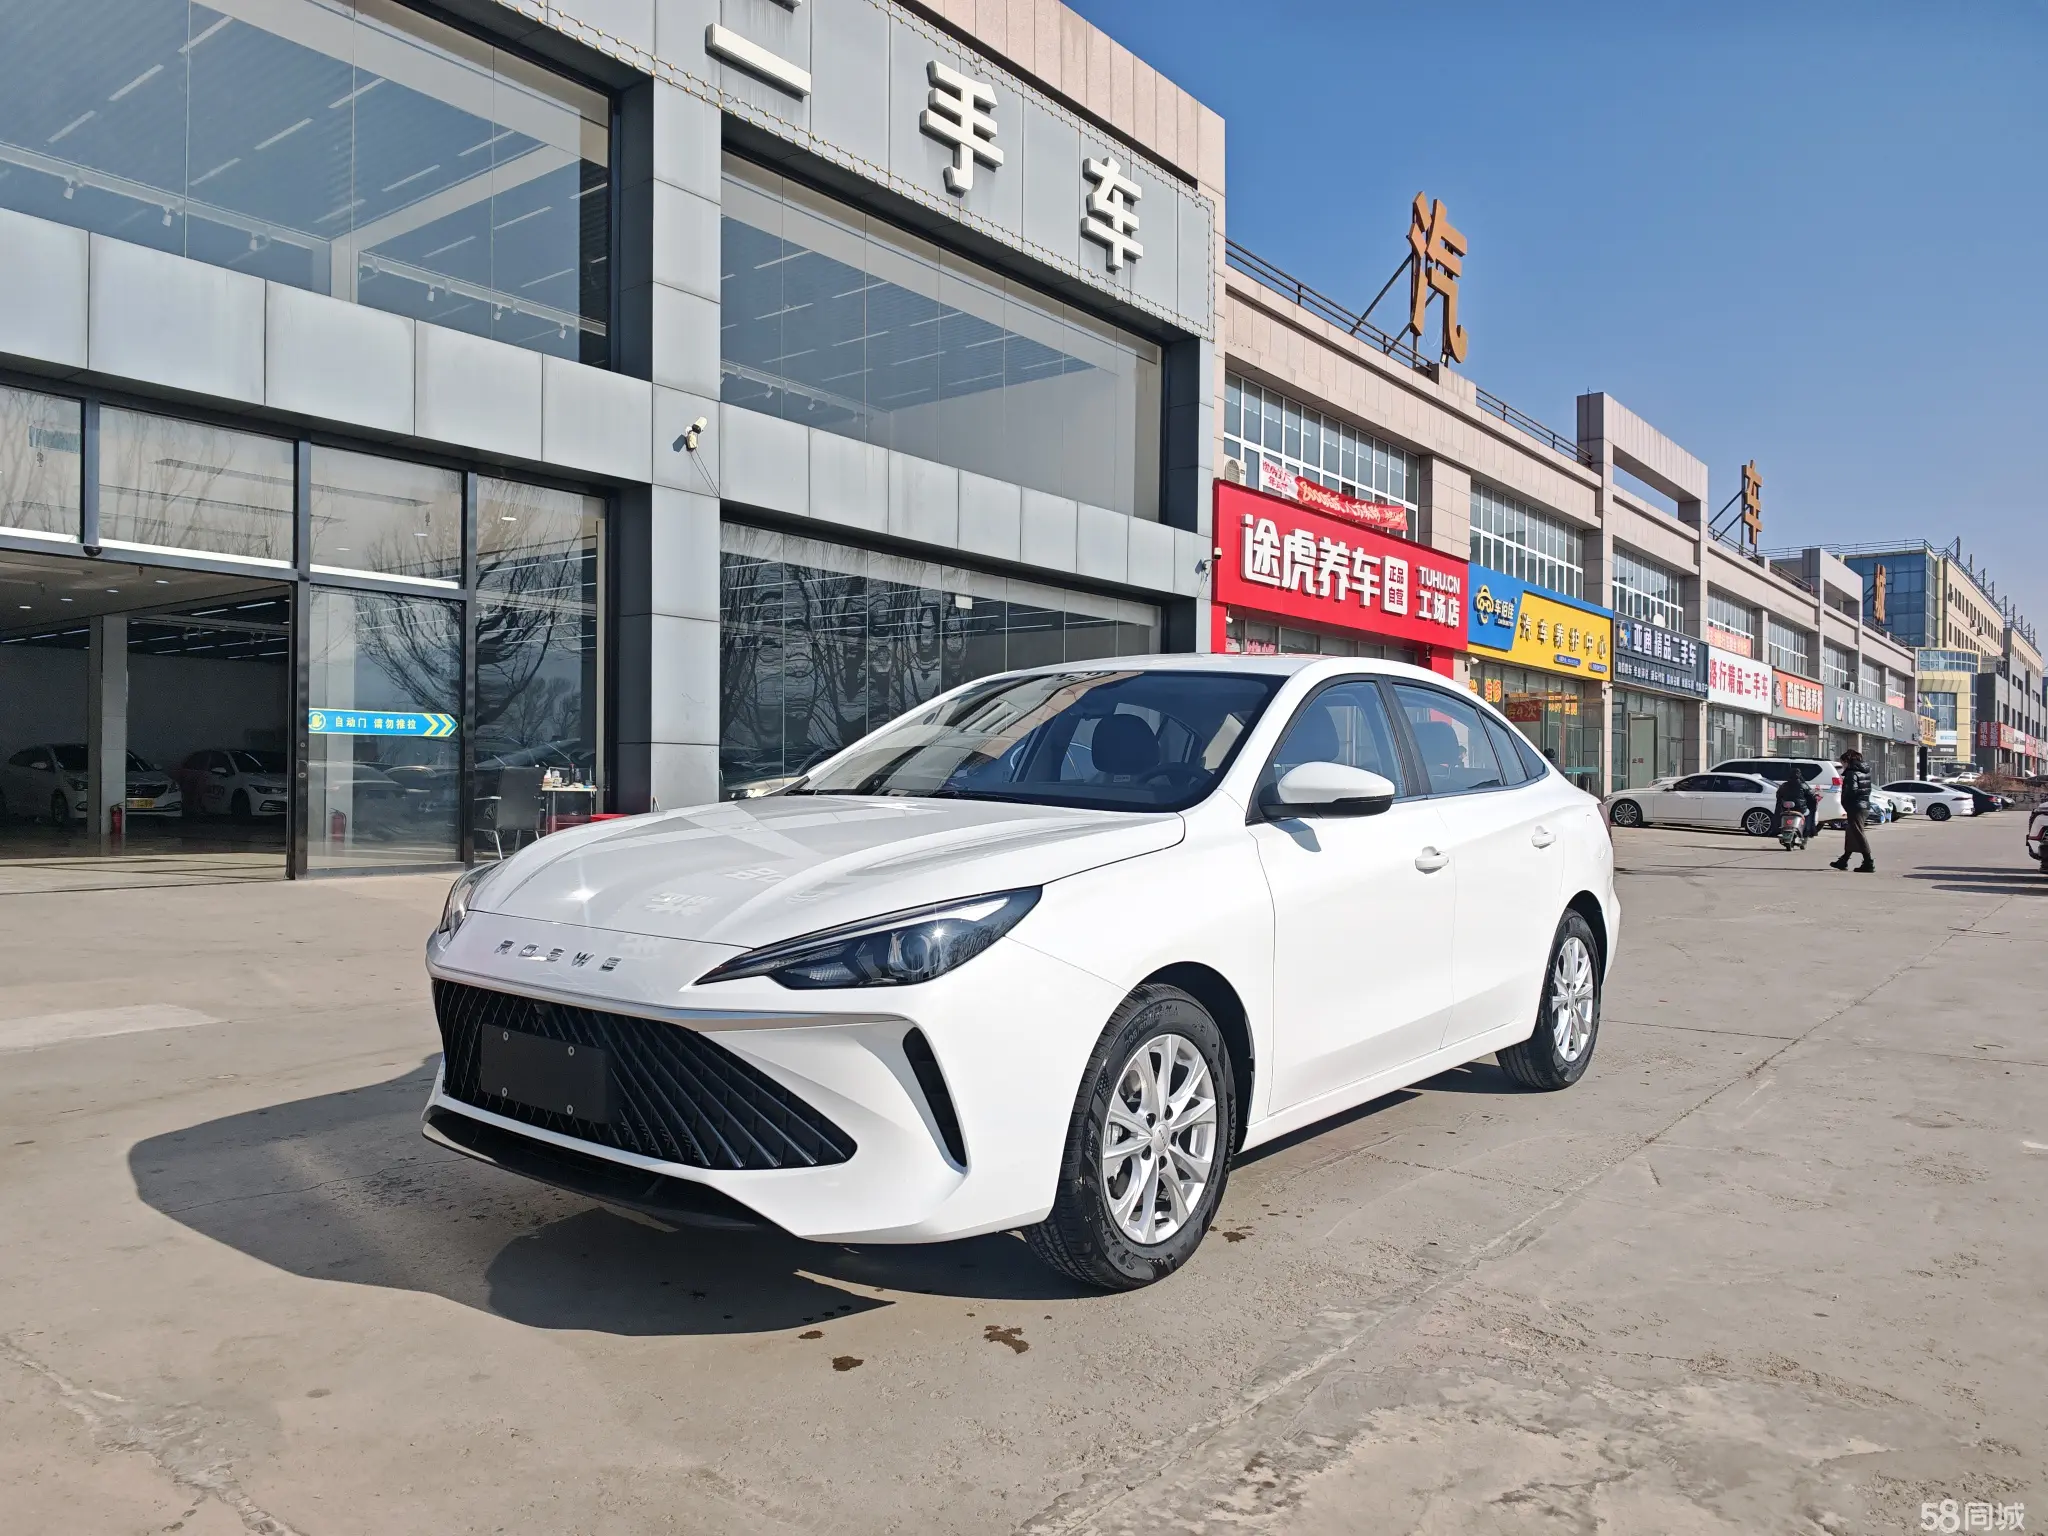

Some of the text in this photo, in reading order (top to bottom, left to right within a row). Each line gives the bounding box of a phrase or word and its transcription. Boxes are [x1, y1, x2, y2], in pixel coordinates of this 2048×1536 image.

[1408, 191, 1468, 363] 汽
[1240, 513, 1381, 607] 途虎养车
[1389, 565, 1405, 585] 正品
[1388, 586, 1404, 607] 自营
[1418, 566, 1461, 595] TUHU.CN
[1417, 590, 1461, 628] 工场店
[1520, 612, 1607, 660] 汽车养护中心
[335, 716, 417, 730] 自动门 请勿推拉
[494, 939, 622, 972] ROEWE
